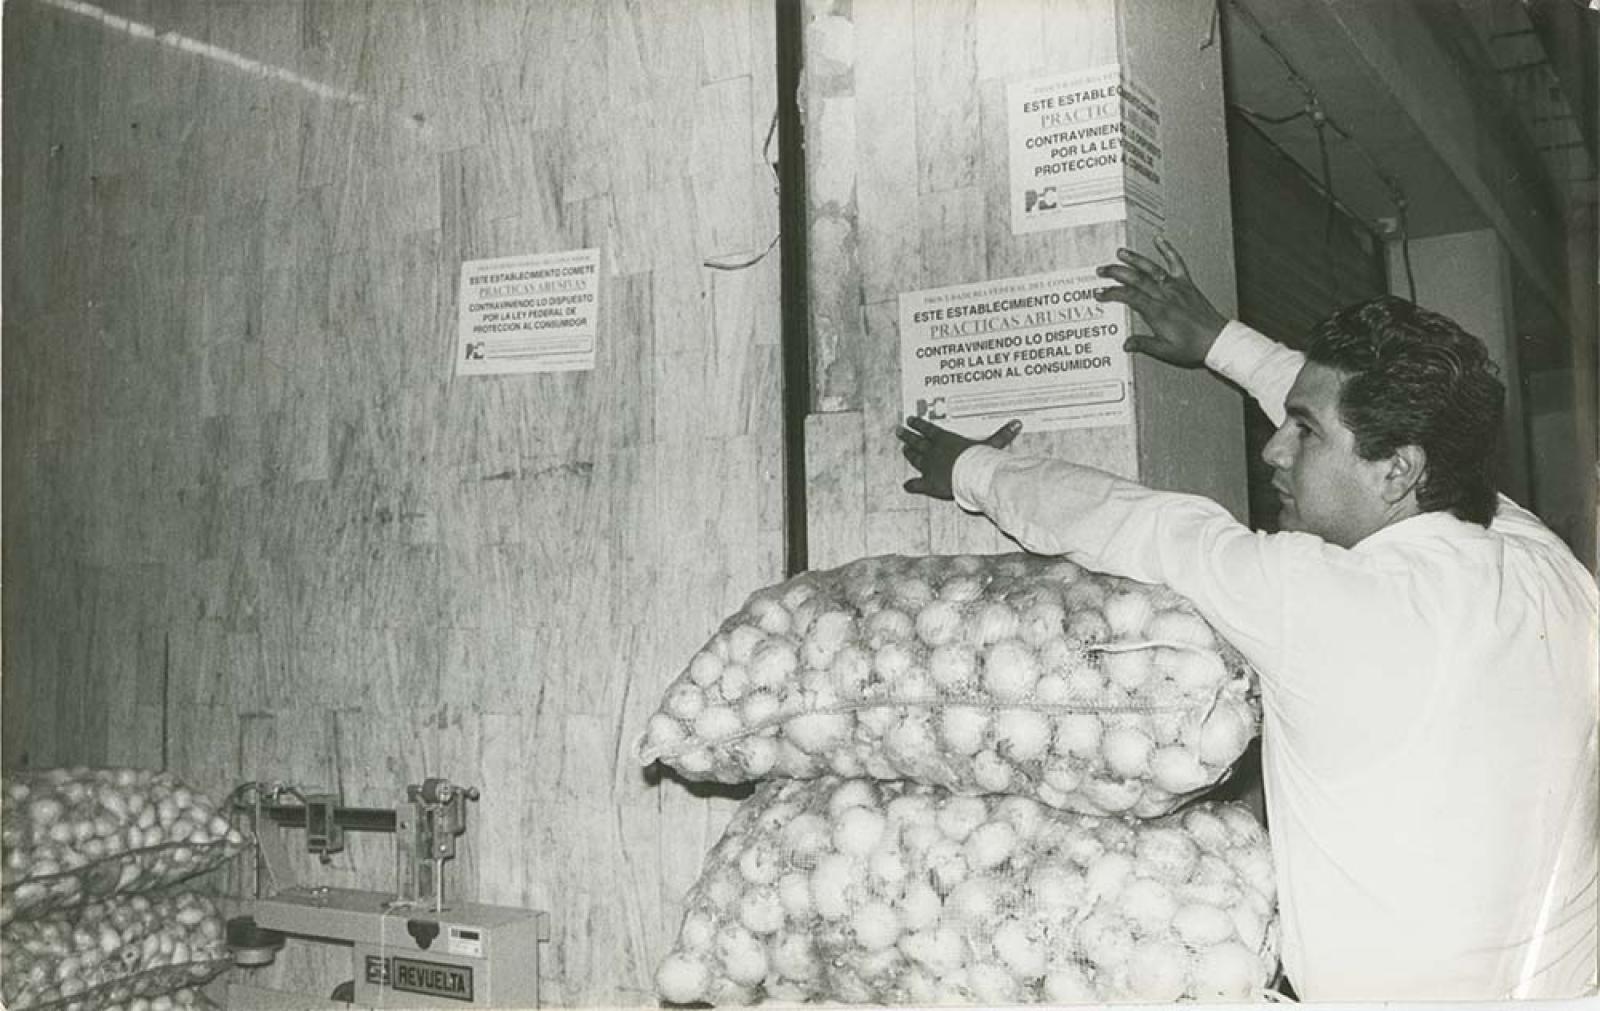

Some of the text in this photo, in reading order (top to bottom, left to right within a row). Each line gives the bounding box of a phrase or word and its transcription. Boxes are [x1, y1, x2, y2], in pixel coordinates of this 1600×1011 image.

[1023, 97, 1057, 113] ESTE
[1051, 145, 1077, 159] POR
[1081, 141, 1098, 154] LA
[1034, 153, 1117, 177] PROTECCION
[470, 274, 488, 286] ESTE
[490, 267, 561, 283] ESTABLECIMIENTO
[562, 263, 595, 276] COMETE
[914, 287, 1100, 323] ESTE ESTABLECIMIENTO COME
[930, 304, 1105, 339] PRACTICAS ABUSIVAS
[915, 323, 1119, 359] CONTRAVINIENDO LO DISPUESTO
[940, 342, 1092, 370] POR LA LEY FEDERAL DE
[924, 355, 1112, 387] PROTECCION AL CONSUMIDOR
[399, 965, 466, 993] REVUELTA
